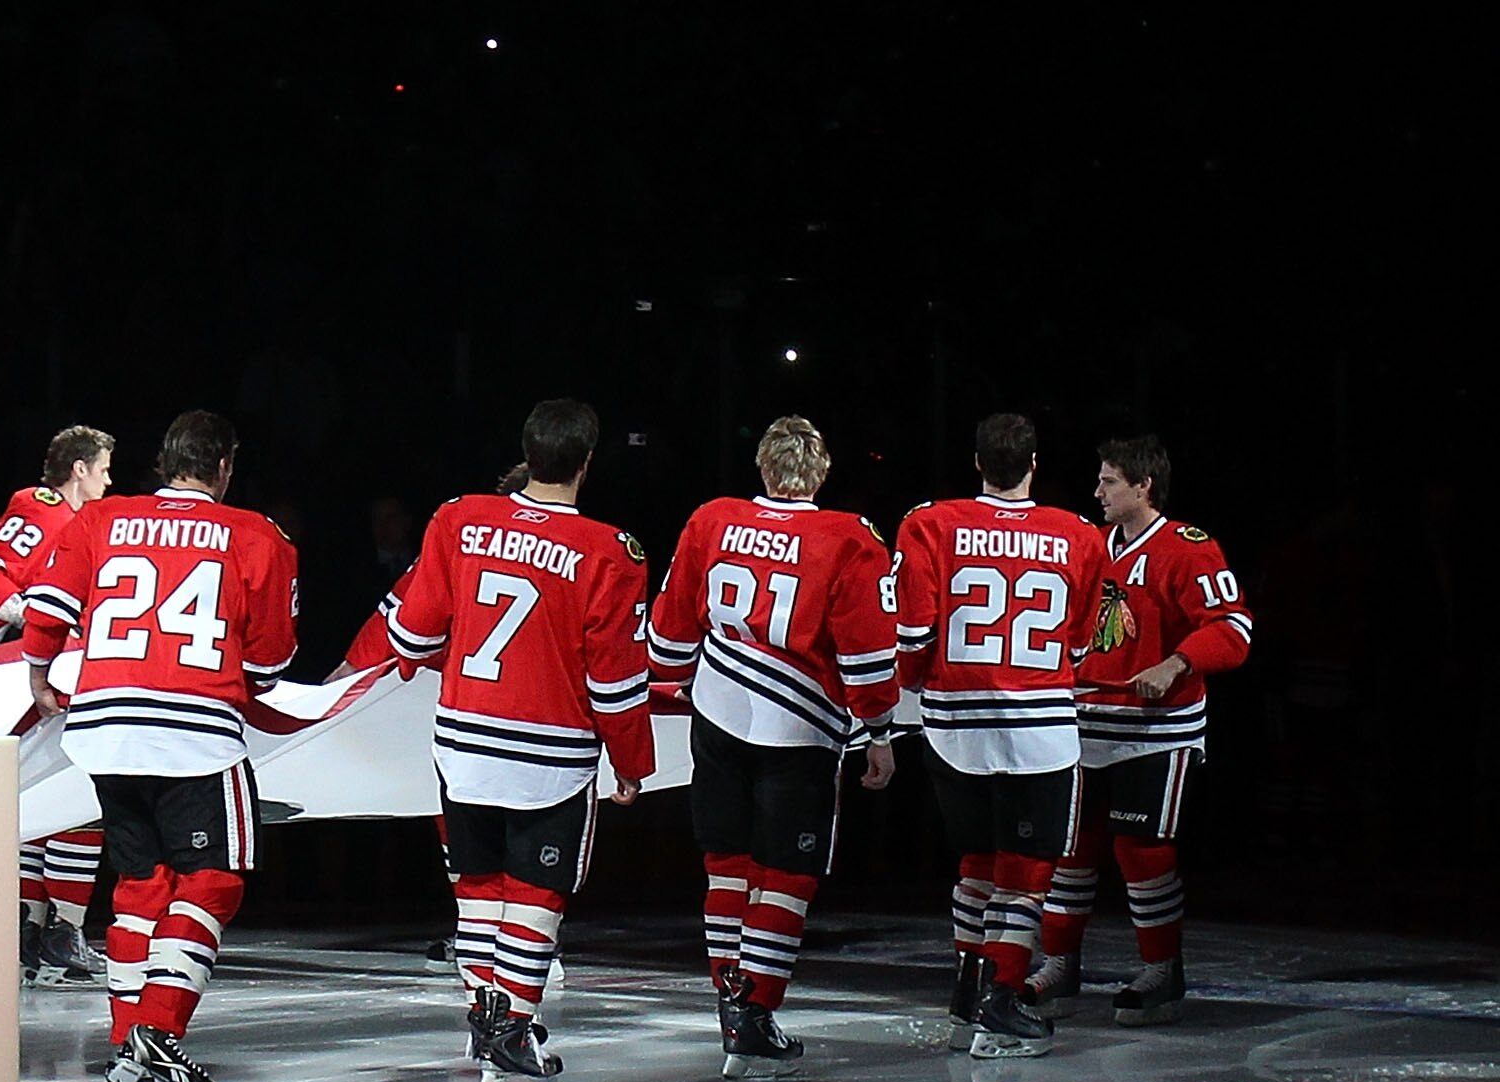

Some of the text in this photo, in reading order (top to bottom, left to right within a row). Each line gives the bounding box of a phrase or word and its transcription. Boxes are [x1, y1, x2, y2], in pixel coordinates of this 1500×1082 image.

[108, 517, 232, 553] BOYNTON
[460, 525, 585, 583] SEABROOK
[720, 524, 801, 565] HOSSA
[954, 527, 1070, 566] BROUWER
[1126, 554, 1148, 586] A
[1196, 569, 1239, 608] 10
[86, 555, 228, 672] 24
[460, 570, 541, 682] 7
[706, 562, 799, 650] 81
[946, 565, 1069, 671] 22
